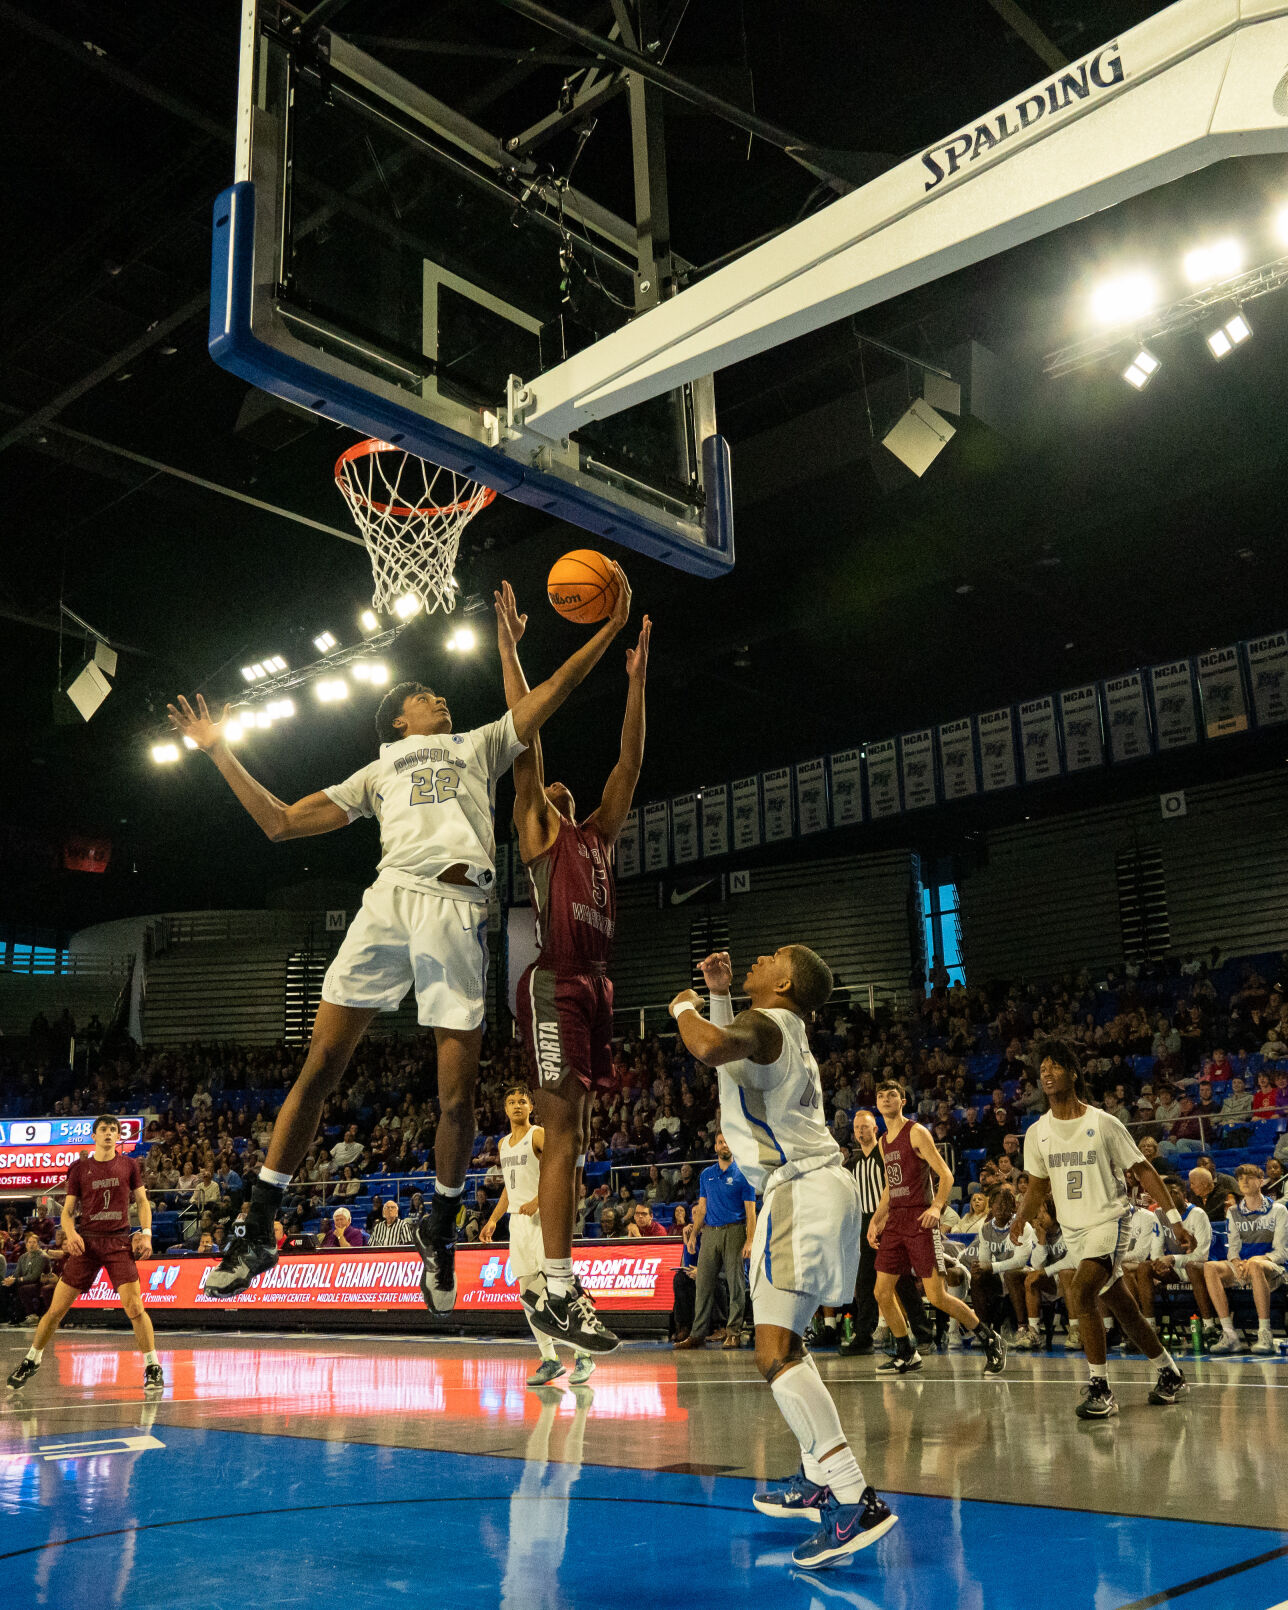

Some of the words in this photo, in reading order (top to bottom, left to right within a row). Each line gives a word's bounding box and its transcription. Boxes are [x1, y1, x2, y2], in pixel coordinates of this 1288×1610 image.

[921, 39, 1124, 191] SPALDING
[1249, 636, 1286, 654] NCAA
[1200, 649, 1235, 668] NCAA
[1155, 663, 1187, 679] NCAA
[1107, 676, 1139, 693] NCAA
[1064, 688, 1093, 703] NCAA
[1021, 700, 1051, 714] NCAA
[981, 711, 1009, 725] NCAA
[941, 721, 969, 736] NCAA
[904, 732, 930, 746] NCAA
[868, 742, 893, 756] NCAA
[833, 752, 857, 764] NCAA
[798, 761, 822, 773] NCAA
[765, 770, 788, 782] NCAA
[410, 767, 460, 806] 22
[733, 778, 755, 791] NCAA
[704, 787, 725, 799] NCAA
[674, 795, 694, 807] NCAA
[1166, 797, 1181, 812] O
[646, 803, 665, 816] NCAA
[734, 874, 746, 888] N
[329, 914, 343, 927] M
[539, 1022, 561, 1081] SPARTA
[25, 1125, 36, 1142] 9
[60, 1123, 92, 1136] 5:48
[1048, 1150, 1097, 1168] ROYALS
[40, 1175, 58, 1184] LIVE
[1066, 1170, 1083, 1200] 2
[103, 1189, 111, 1210] 1
[1152, 1222, 1160, 1237] 4
[590, 1258, 635, 1275] DON'T
[633, 1258, 662, 1275] LET
[261, 1263, 334, 1289] BASKETBALL
[334, 1260, 425, 1288] CHAMPIONSH
[581, 1274, 615, 1288] DRIVE
[614, 1274, 659, 1288] DRUNK
[145, 1293, 178, 1303] Tennessee
[237, 1294, 257, 1302] FINALS
[262, 1293, 287, 1302] MURPHY
[287, 1293, 311, 1302] CENTER
[316, 1293, 340, 1302] MIDDLE
[340, 1292, 378, 1302] TENNESSEE
[377, 1292, 397, 1302] STATE
[463, 1290, 476, 1302] of
